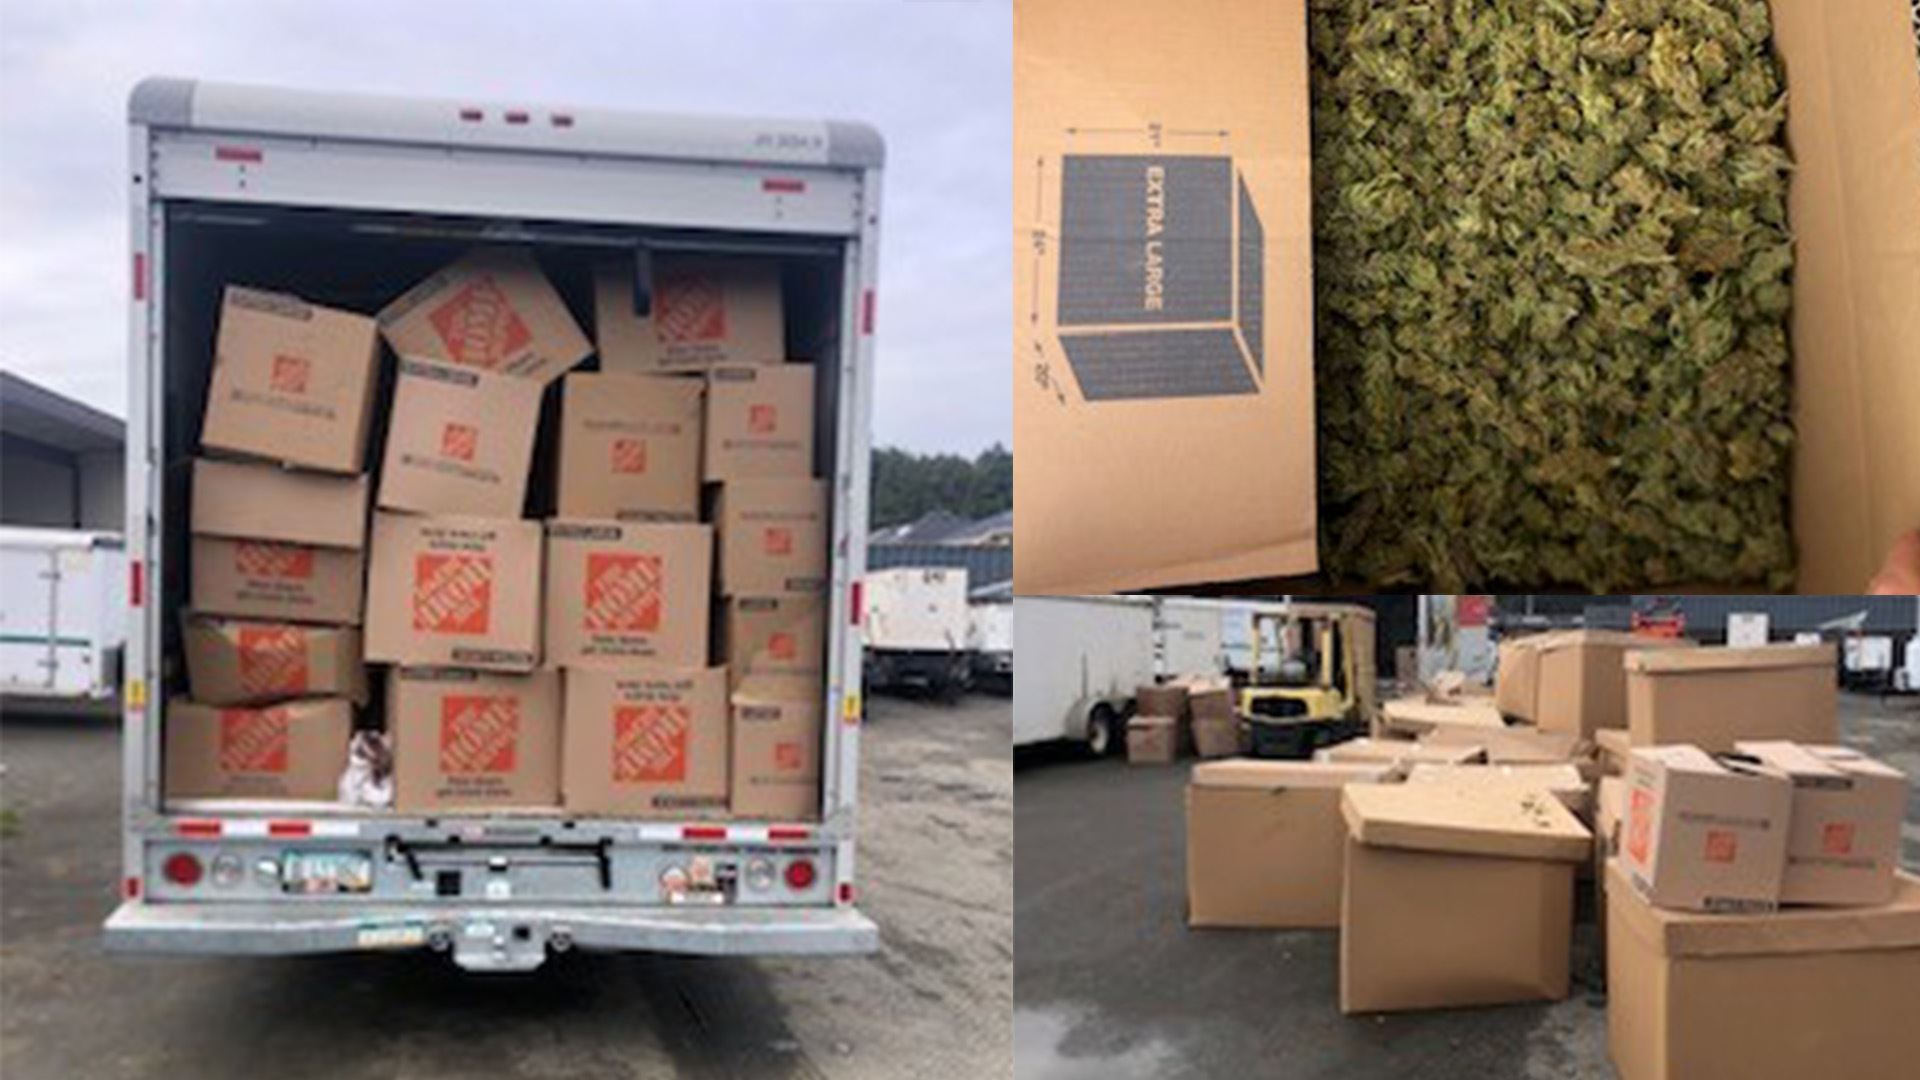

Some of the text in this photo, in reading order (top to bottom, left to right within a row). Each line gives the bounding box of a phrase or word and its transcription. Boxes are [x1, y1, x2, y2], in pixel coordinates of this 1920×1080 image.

[1144, 165, 1165, 311] EXTRA LARGE
[418, 560, 492, 629] HOME
[586, 558, 657, 629] HOME
[439, 699, 510, 771] HOME
[615, 709, 687, 780] HOME
